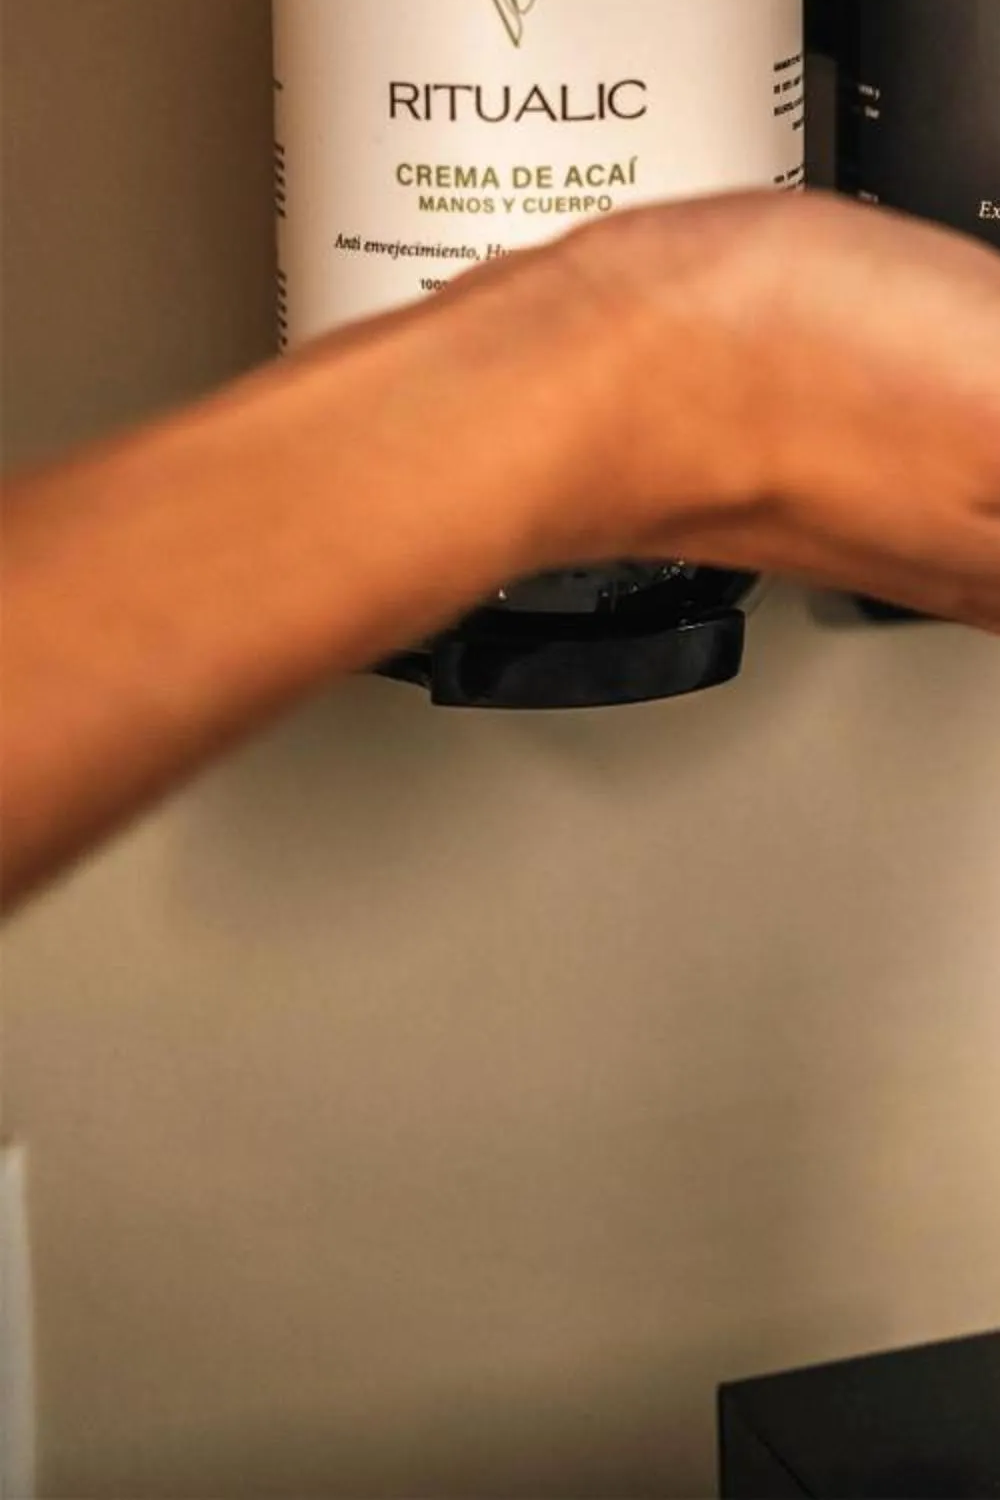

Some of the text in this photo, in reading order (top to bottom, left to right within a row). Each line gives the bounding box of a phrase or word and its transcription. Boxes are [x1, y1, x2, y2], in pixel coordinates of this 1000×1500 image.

[388, 79, 647, 122] RITUALIC
[396, 156, 638, 189] CREMA DE ACAÍ
[418, 194, 613, 214] MANOS Y CUERPO
[334, 233, 362, 252] Anti
[363, 239, 481, 261] envejecimiento,
